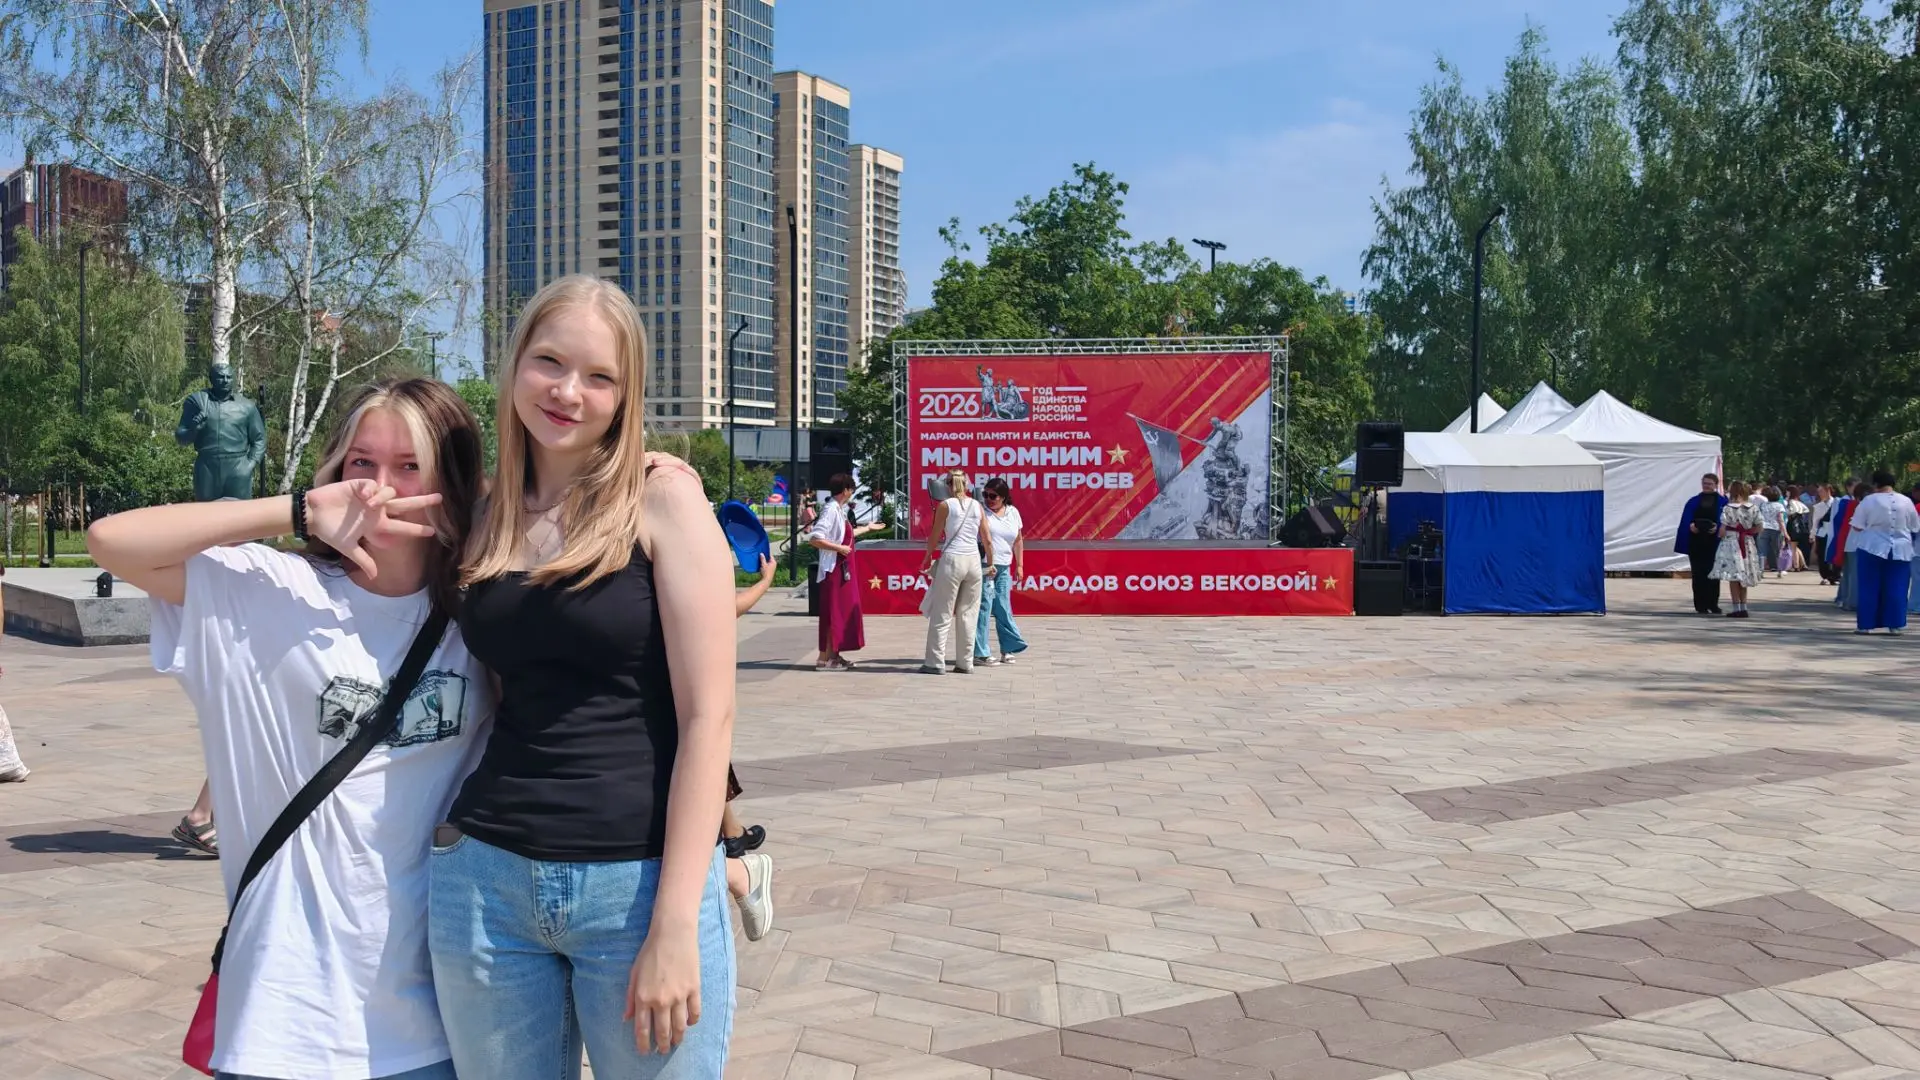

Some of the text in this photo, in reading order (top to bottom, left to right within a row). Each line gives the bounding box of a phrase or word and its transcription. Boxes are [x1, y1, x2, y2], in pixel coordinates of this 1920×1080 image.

[1032, 386, 1054, 396] ГОД
[919, 394, 979, 416] 2026
[1032, 395, 1087, 405] ЕДИНСТВА
[1032, 404, 1082, 413] НАРОДОВ
[1032, 413, 1075, 422] РОССИИ
[920, 431, 1091, 441] МАРАФОН ПАМЯТИ И ЕДИНСТВА
[921, 446, 1102, 466] МЫ ПОМНИМ
[1043, 472, 1135, 489] ГЕРОЕВ
[1009, 570, 1317, 593] НАРОДОВ СОЮЗ ВЕКОВОЙ!
